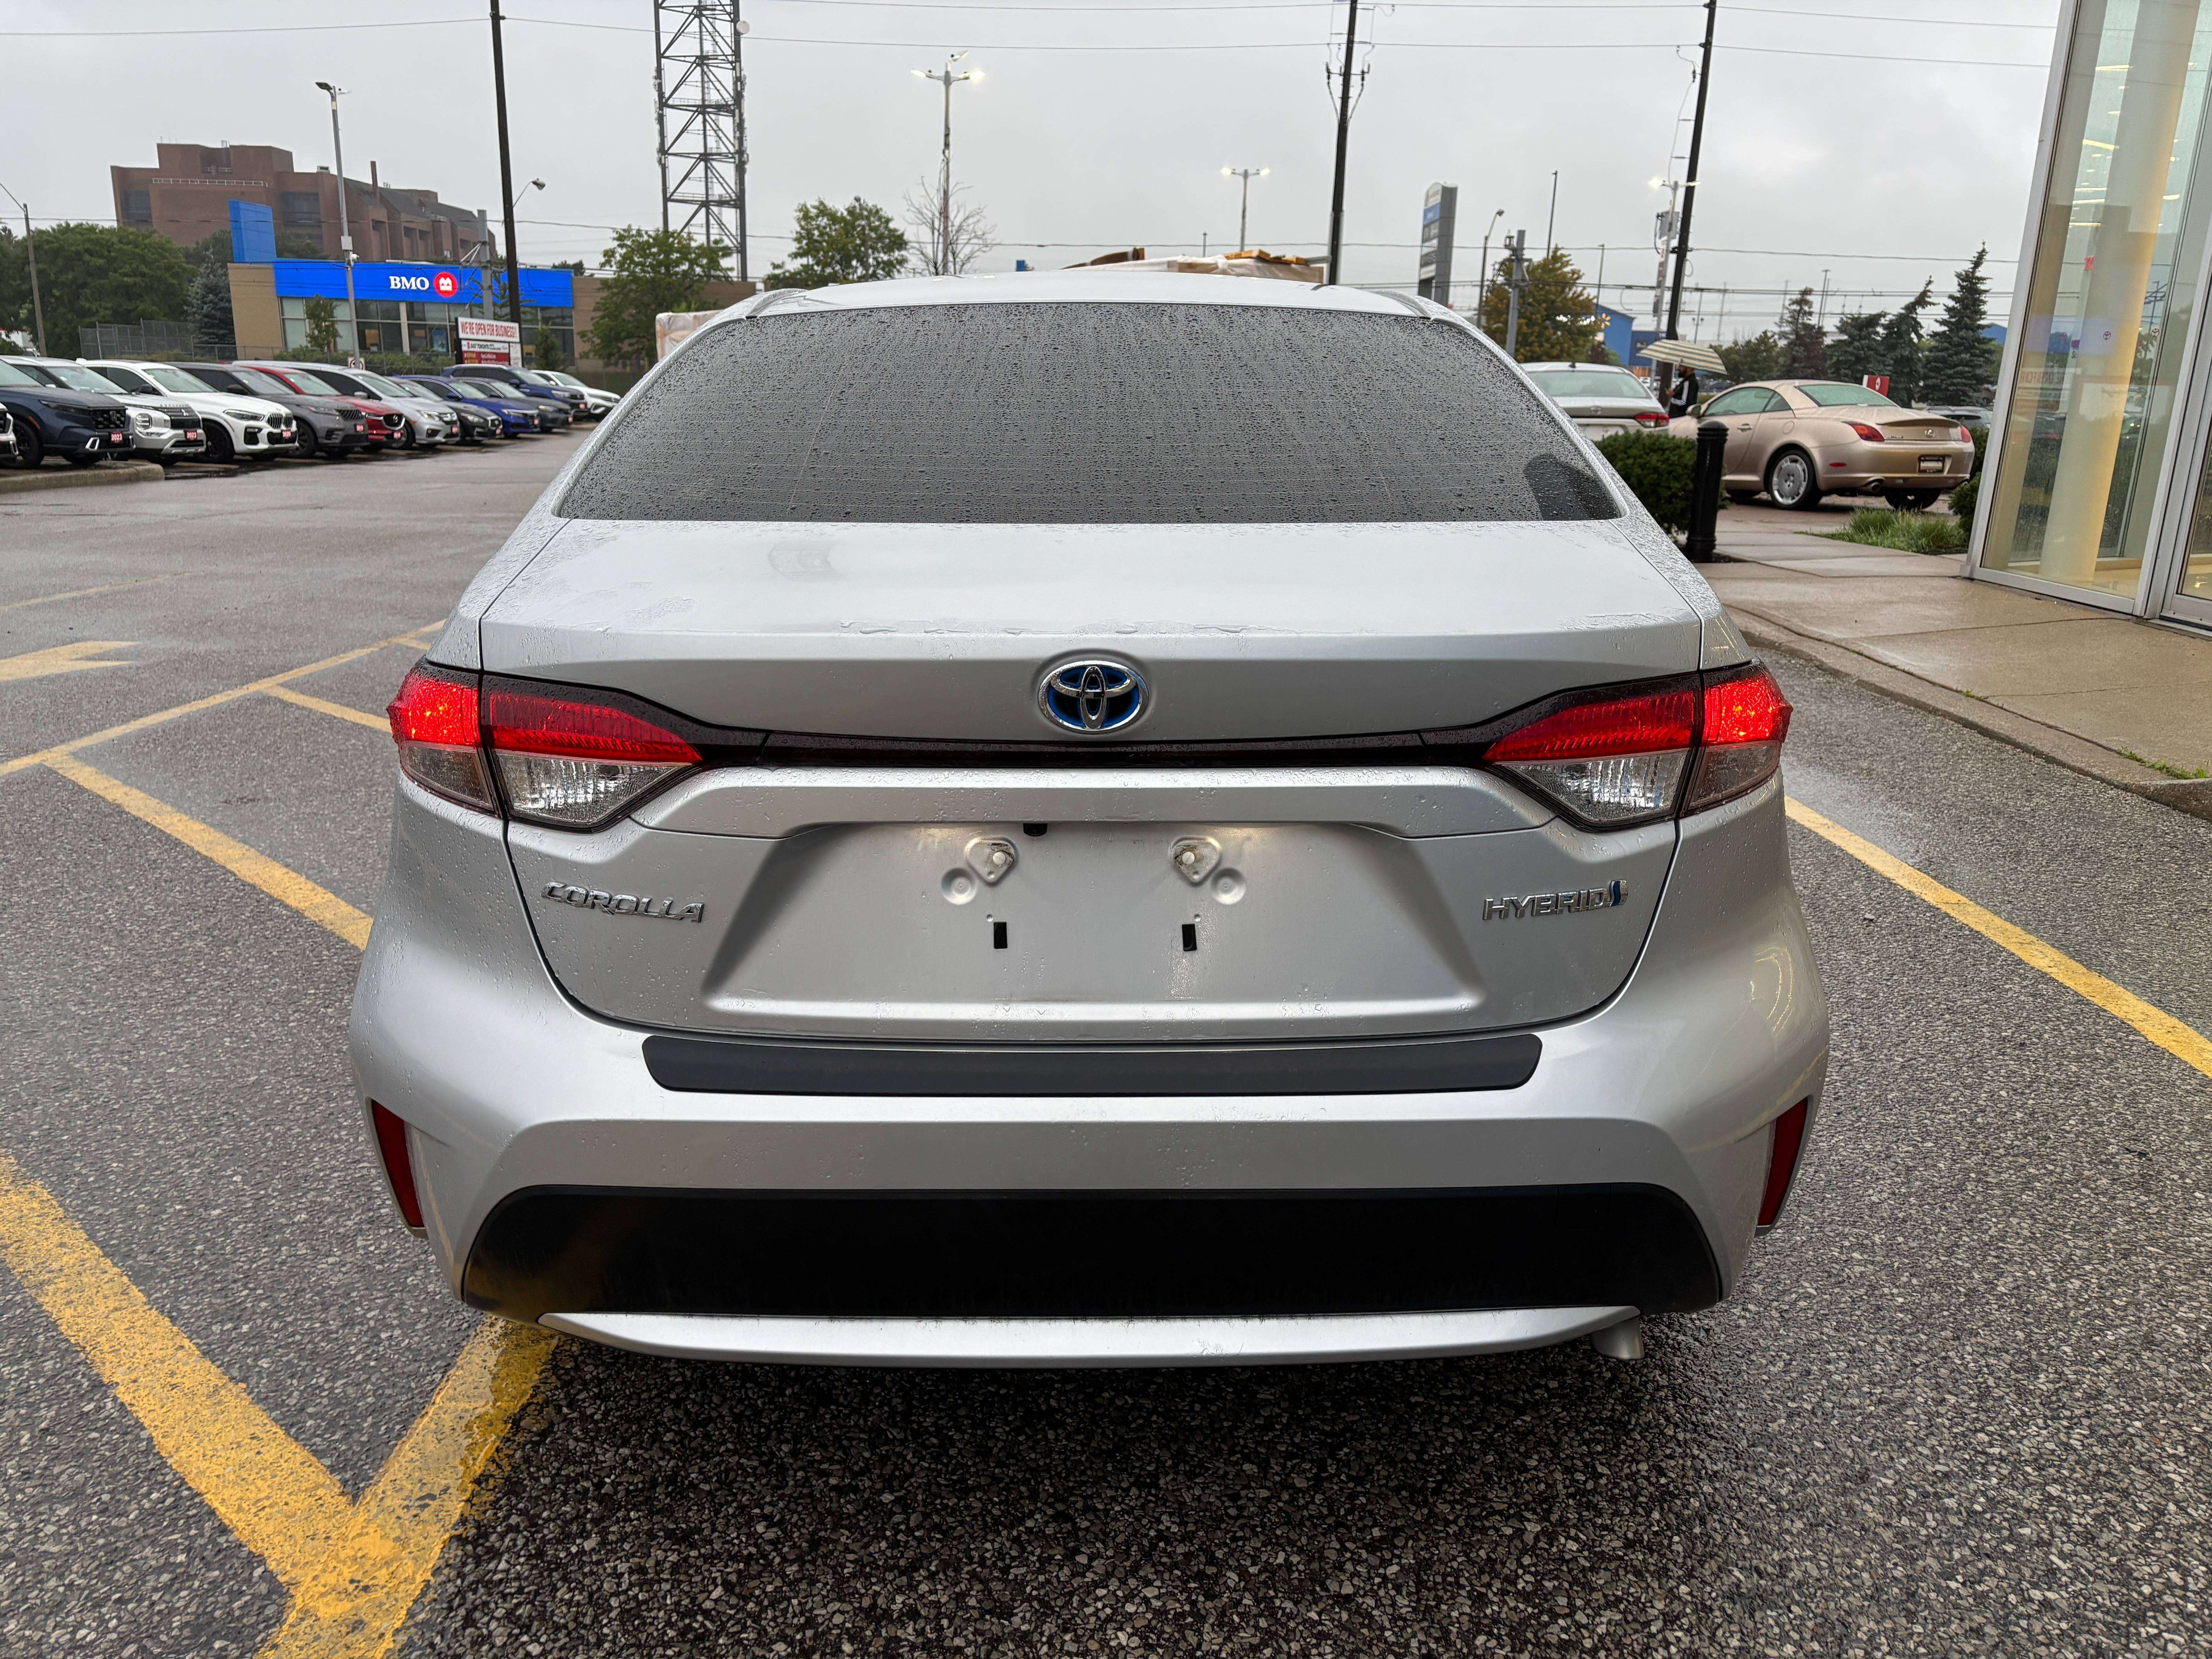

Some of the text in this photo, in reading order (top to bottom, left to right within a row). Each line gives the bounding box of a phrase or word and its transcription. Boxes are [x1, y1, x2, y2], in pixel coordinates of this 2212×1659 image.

[389, 276, 429, 290] BMO
[460, 321, 474, 335] WE'RE
[475, 323, 486, 336] OPEN
[541, 882, 704, 923] COROLLA
[1482, 888, 1608, 921] HYBRID
